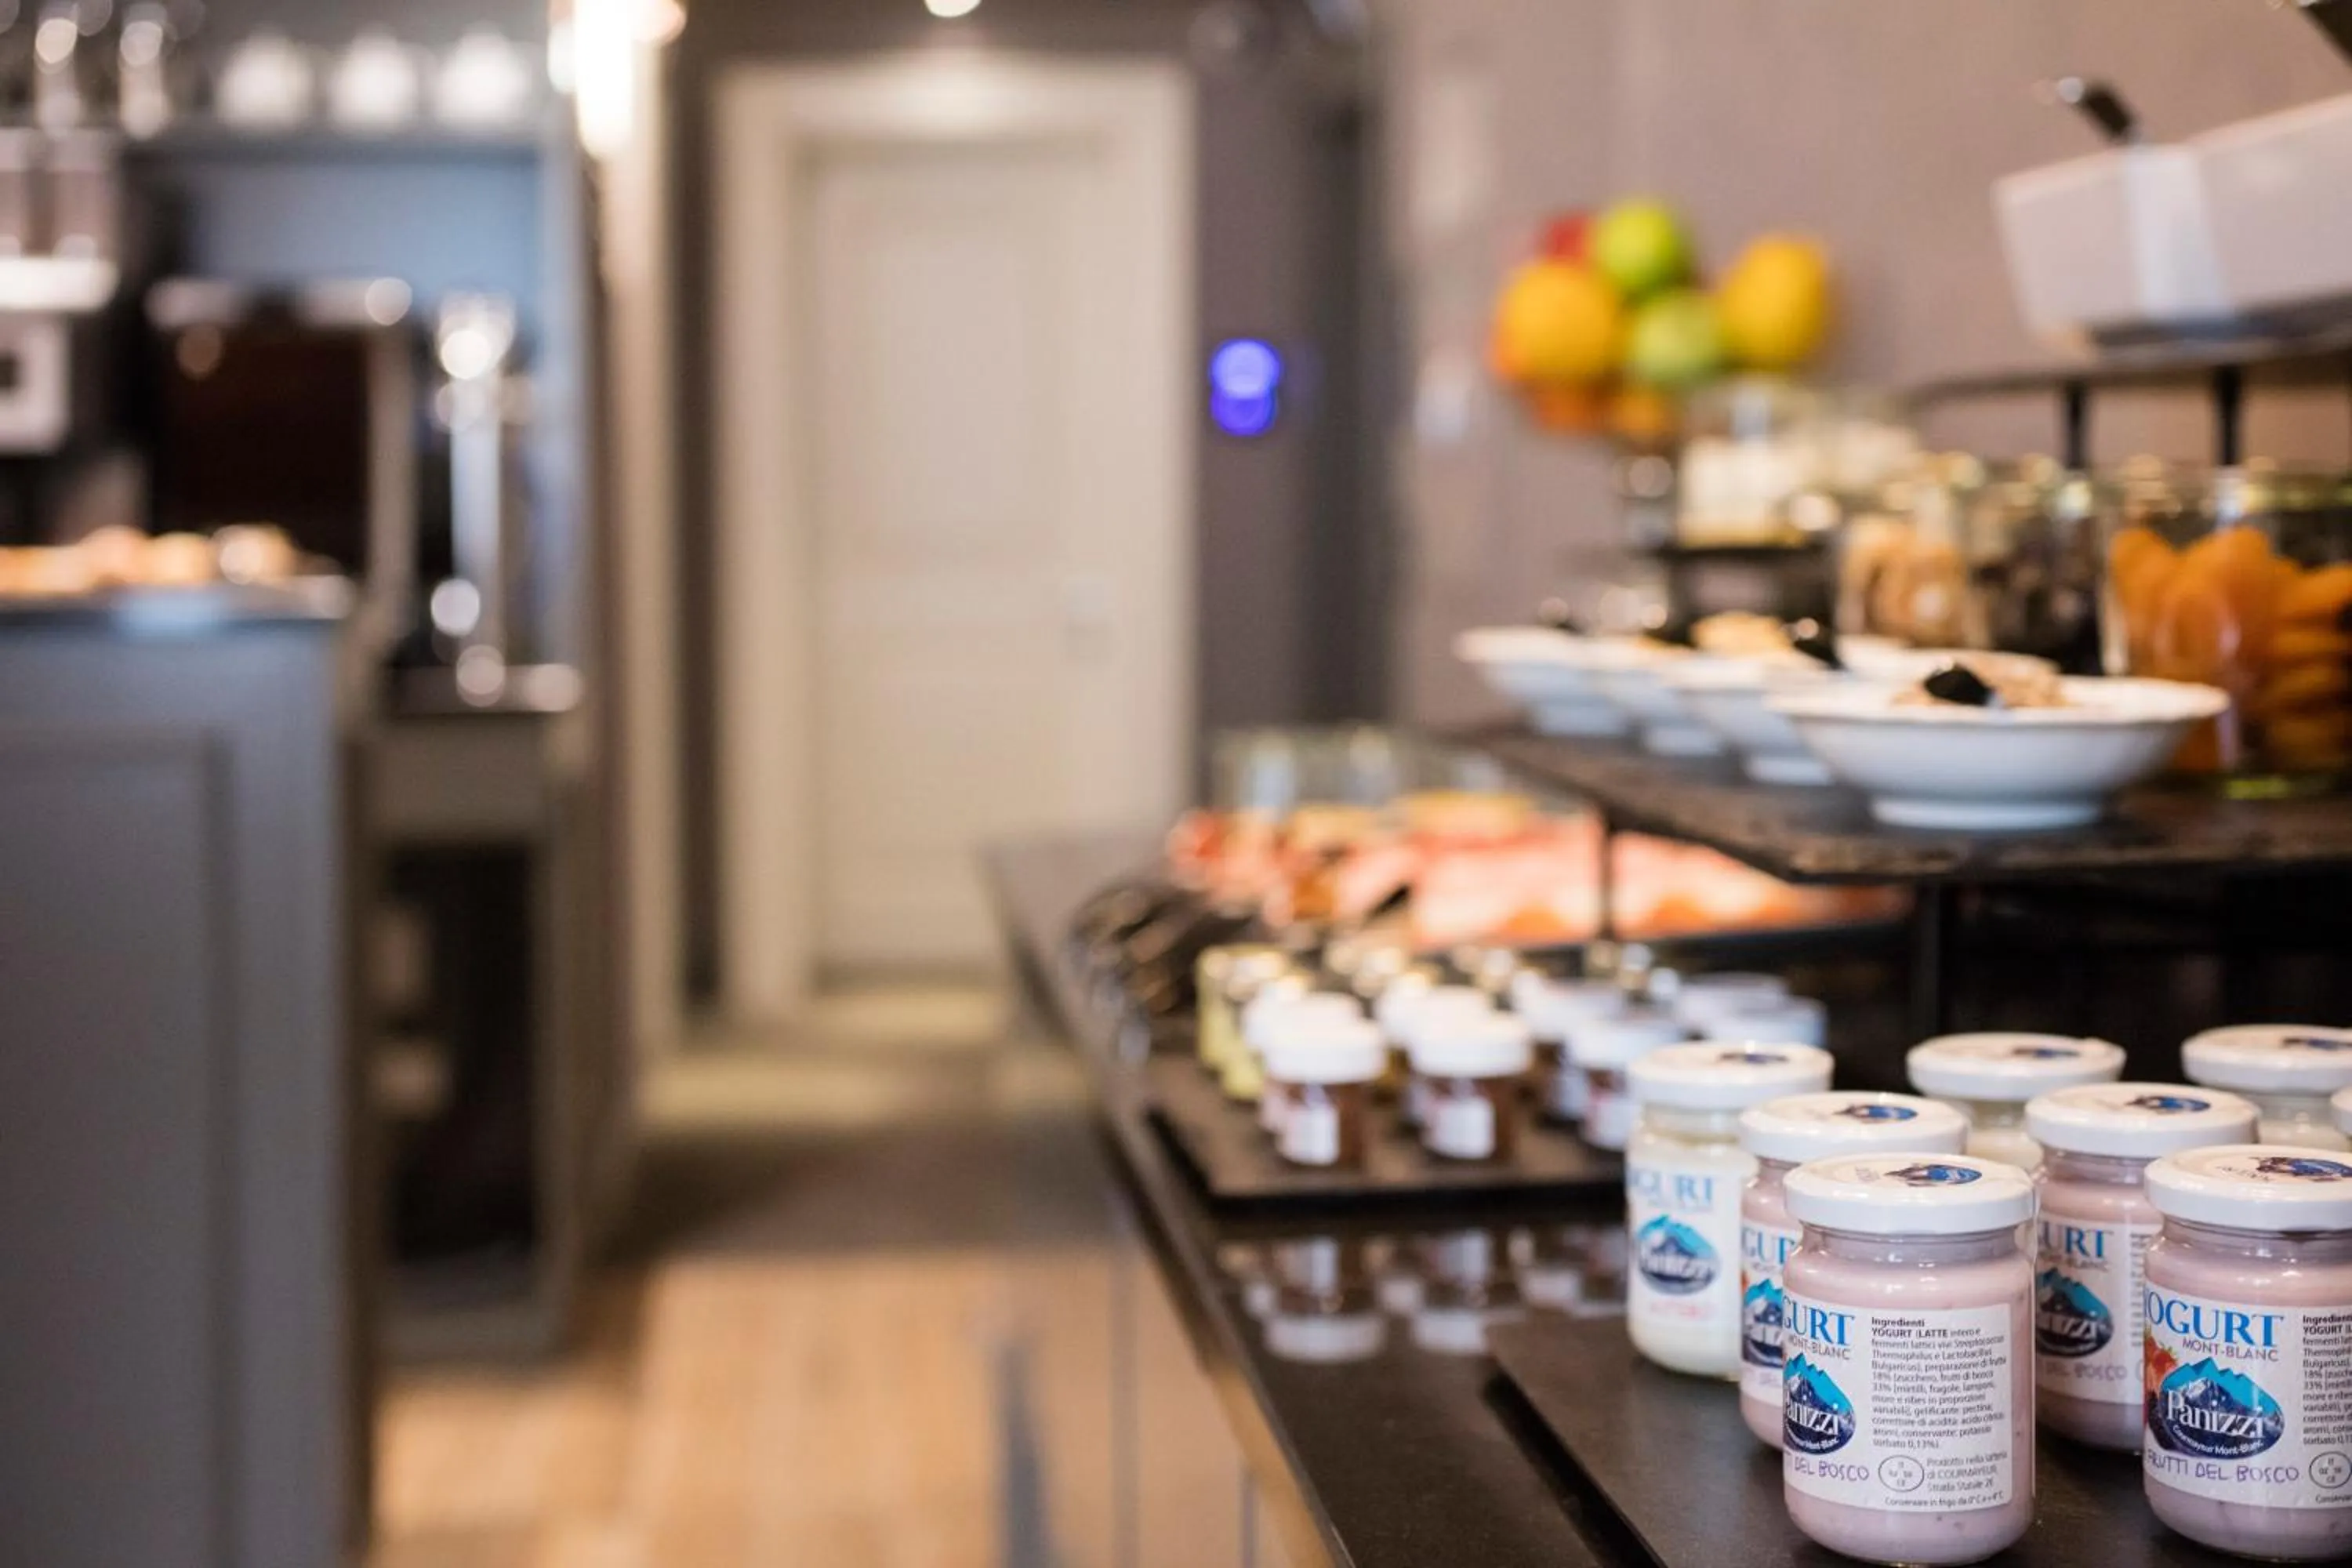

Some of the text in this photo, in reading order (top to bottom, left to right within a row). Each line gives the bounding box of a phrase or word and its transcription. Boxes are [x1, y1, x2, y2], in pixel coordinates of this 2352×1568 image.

[1872, 1317, 1925, 1327] Ingredienti
[2147, 1290, 2285, 1348] OGURT
[2303, 1325, 2343, 1335] YOGURT
[1872, 1327, 1911, 1338] YOGURT
[1872, 1339, 1907, 1349] fermenti
[2182, 1337, 2280, 1362] MONT-BLANC
[2167, 1389, 2265, 1439] Panizzi
[2172, 1424, 2214, 1452] Courmayeur
[1794, 1456, 1871, 1482] DEL BOSCO
[2147, 1449, 2300, 1483] FRUTTI DEL BOSCO
